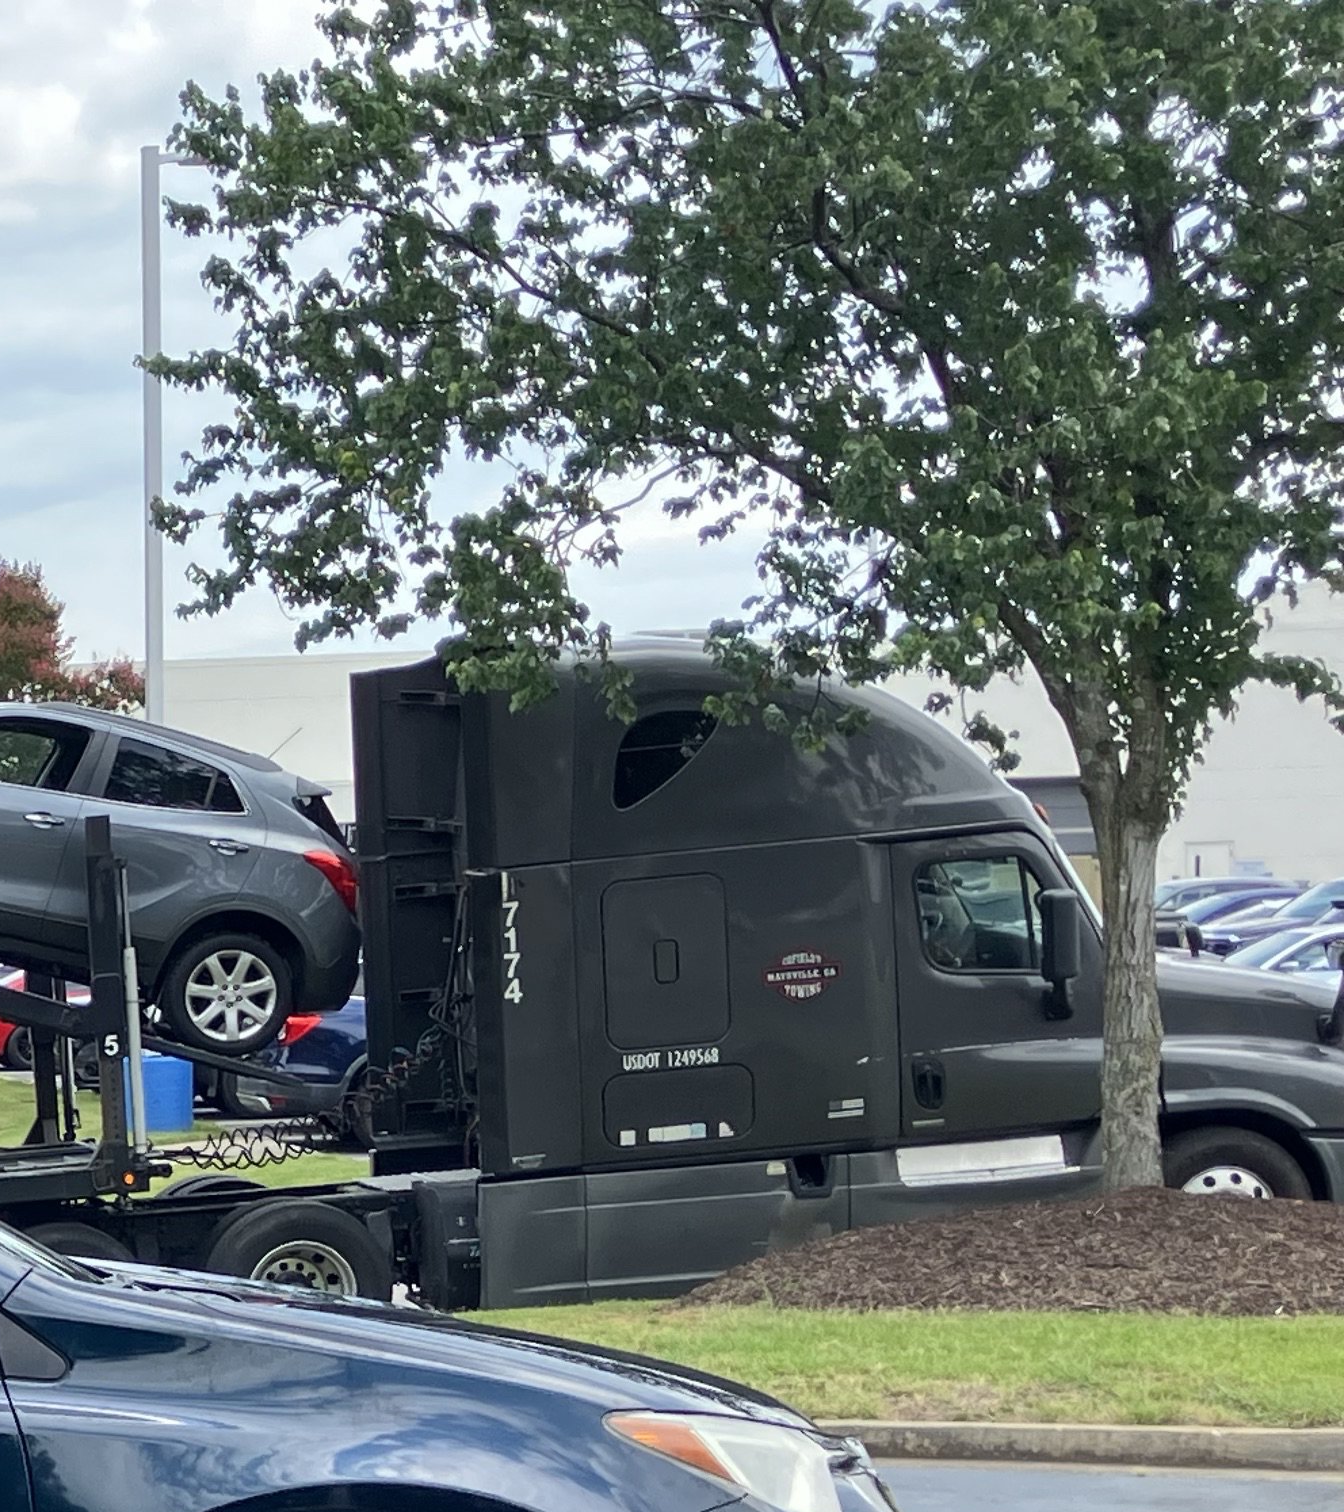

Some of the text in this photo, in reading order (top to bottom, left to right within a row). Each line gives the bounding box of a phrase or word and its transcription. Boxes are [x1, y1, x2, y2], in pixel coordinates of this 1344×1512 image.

[784, 982, 822, 998] TOWING
[104, 1034, 119, 1056] 5
[623, 1047, 719, 1071] USDOT 1249568
